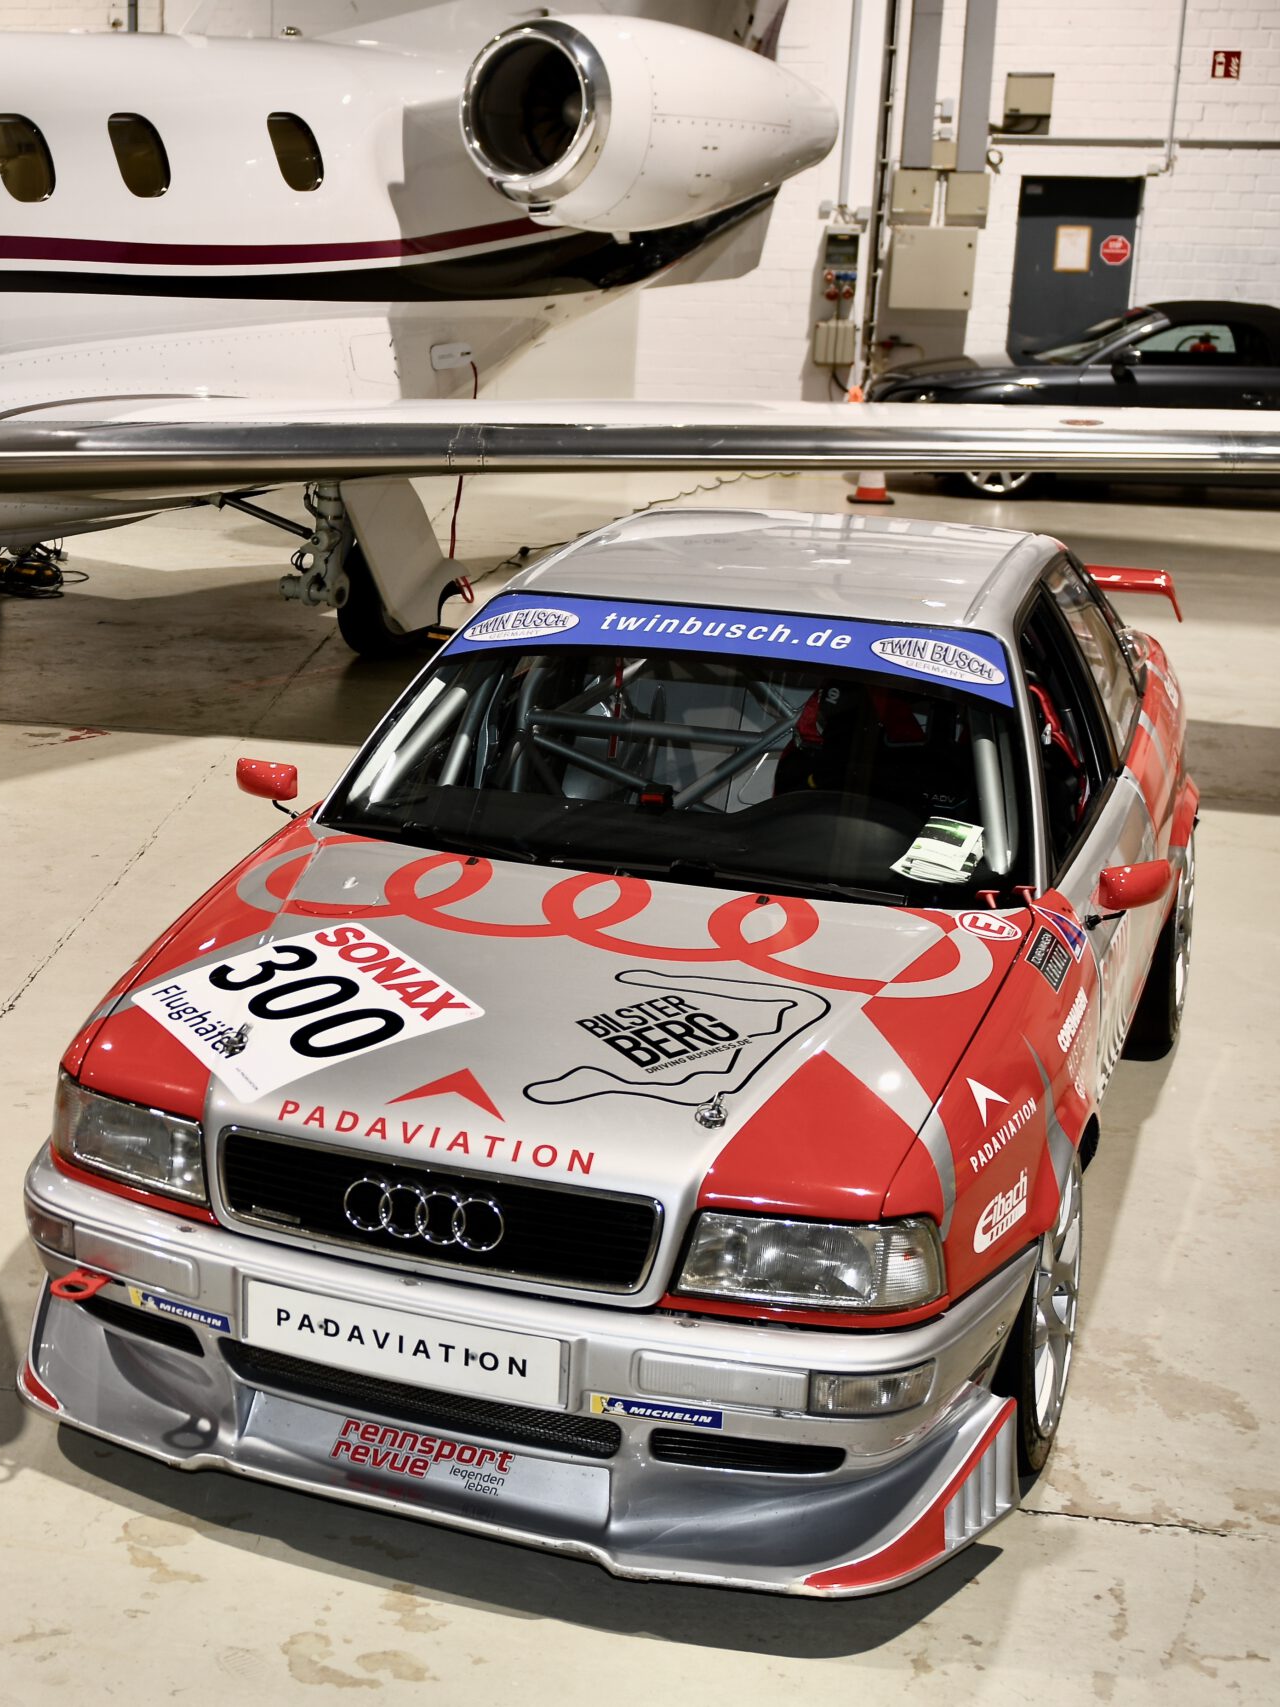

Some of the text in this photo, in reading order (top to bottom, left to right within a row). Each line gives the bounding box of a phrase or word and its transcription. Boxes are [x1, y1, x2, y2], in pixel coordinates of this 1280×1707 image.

[470, 609, 570, 637] TWIN BUSCH
[489, 630, 541, 640] GERMANY
[600, 612, 853, 650] twinbusch.de
[879, 638, 995, 679] TWIN BUSCH
[905, 660, 966, 680] GERMANY
[314, 926, 471, 1022] SONAX
[209, 945, 405, 1058] 300
[575, 995, 701, 1039] BILSTER
[602, 1012, 739, 1068] BERG
[645, 1038, 753, 1074] DRIVING BUSINESS.DE
[277, 1099, 595, 1175] PADAVIATION
[970, 1097, 1037, 1173] PADAVIATION
[974, 1169, 1028, 1250] Eibach
[159, 1302, 222, 1327] MICHELIN
[276, 1308, 528, 1378] PADAVIATION
[629, 1406, 713, 1424] MICHELIN
[330, 1440, 431, 1478] revue
[339, 1417, 514, 1474] rennsport
[449, 1464, 505, 1487] legenden
[464, 1479, 500, 1497] leben.
